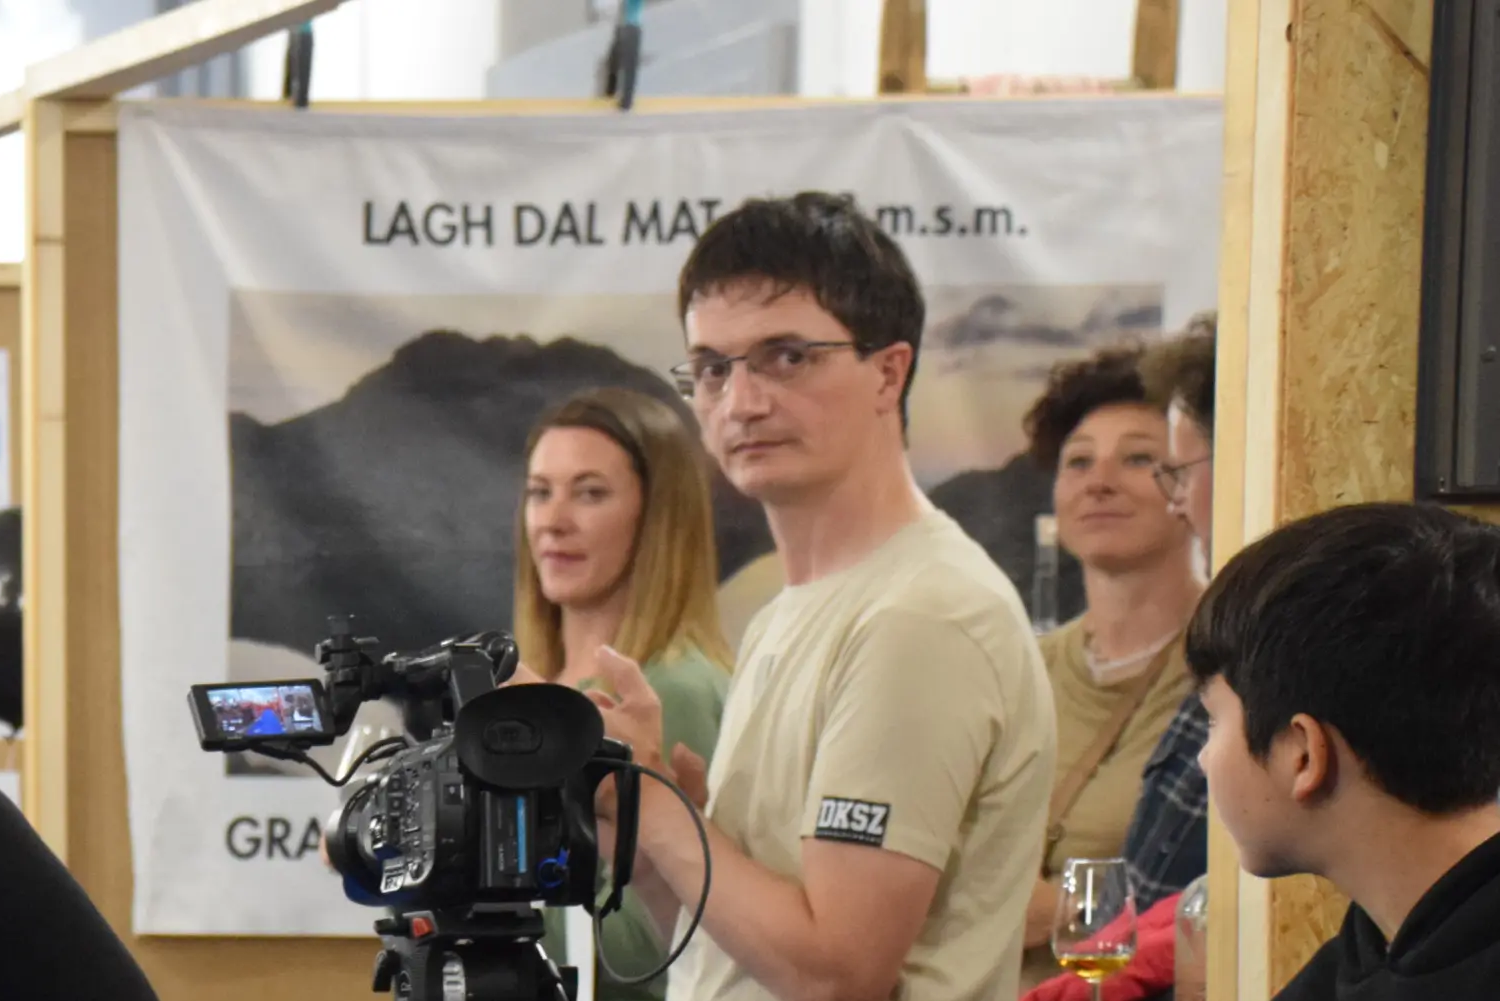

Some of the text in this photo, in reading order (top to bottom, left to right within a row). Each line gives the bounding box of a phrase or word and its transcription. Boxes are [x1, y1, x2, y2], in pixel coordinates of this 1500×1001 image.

[364, 200, 494, 246] LAGH
[513, 200, 605, 246] DAL
[876, 205, 1029, 236] m.s.m.
[817, 799, 887, 835] DKSZ
